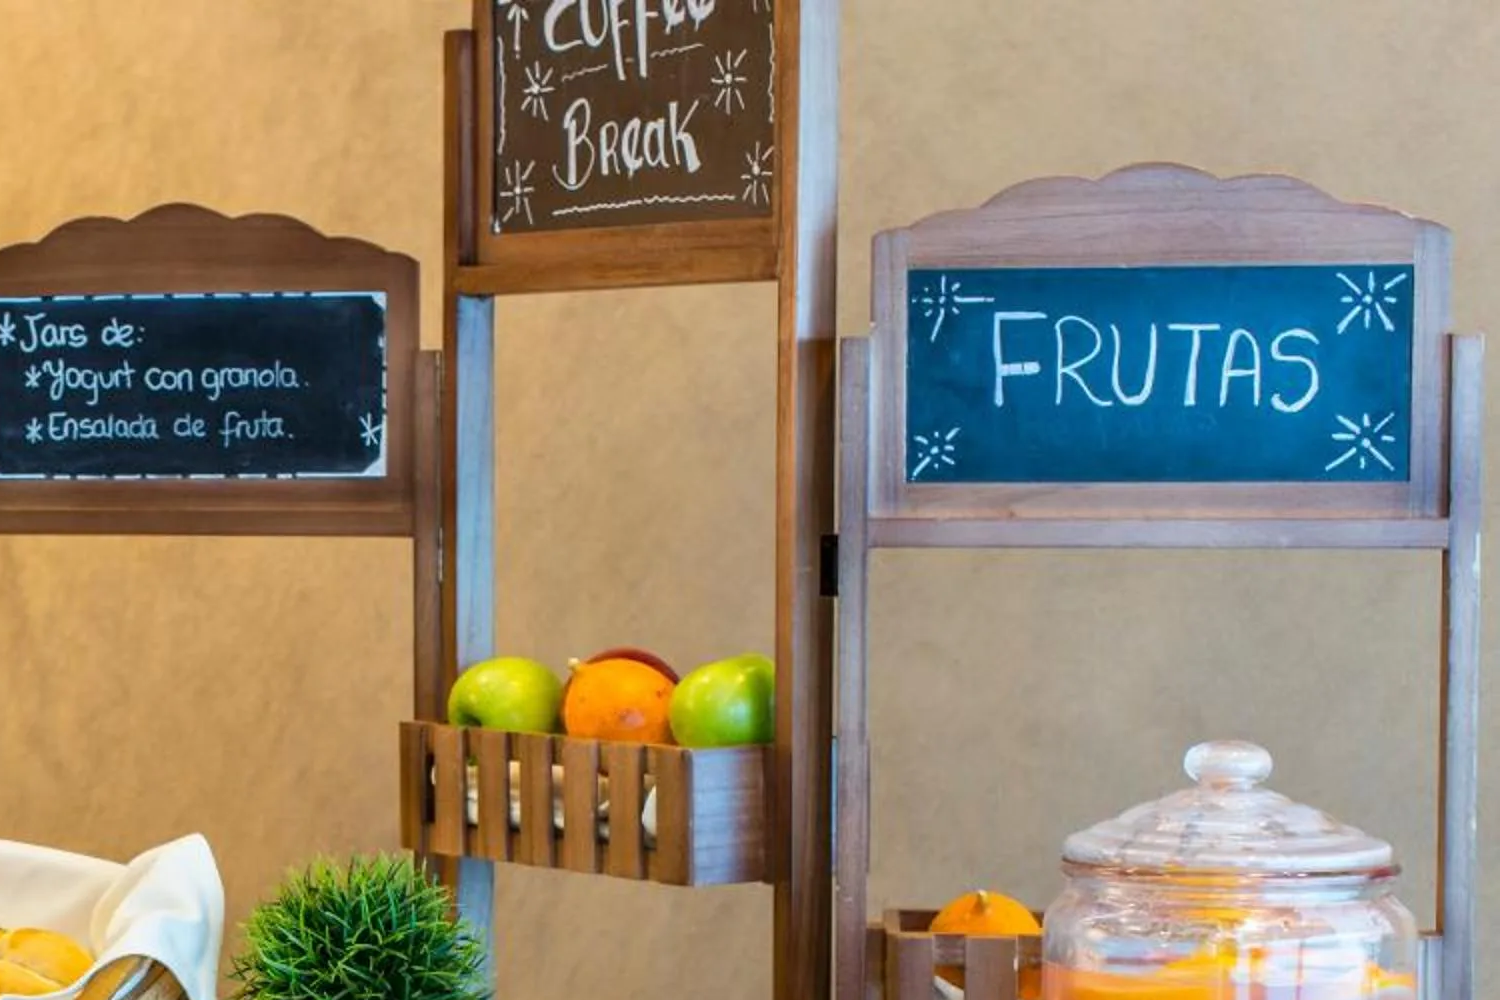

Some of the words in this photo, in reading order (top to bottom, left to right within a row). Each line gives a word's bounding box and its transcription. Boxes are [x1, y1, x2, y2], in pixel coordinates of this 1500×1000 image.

[19, 311, 88, 353] Jars
[41, 358, 136, 406] Yogurt
[144, 366, 194, 392] con
[991, 311, 1320, 413] FRUTAS
[47, 411, 160, 440] Ensalada
[173, 413, 206, 438] de
